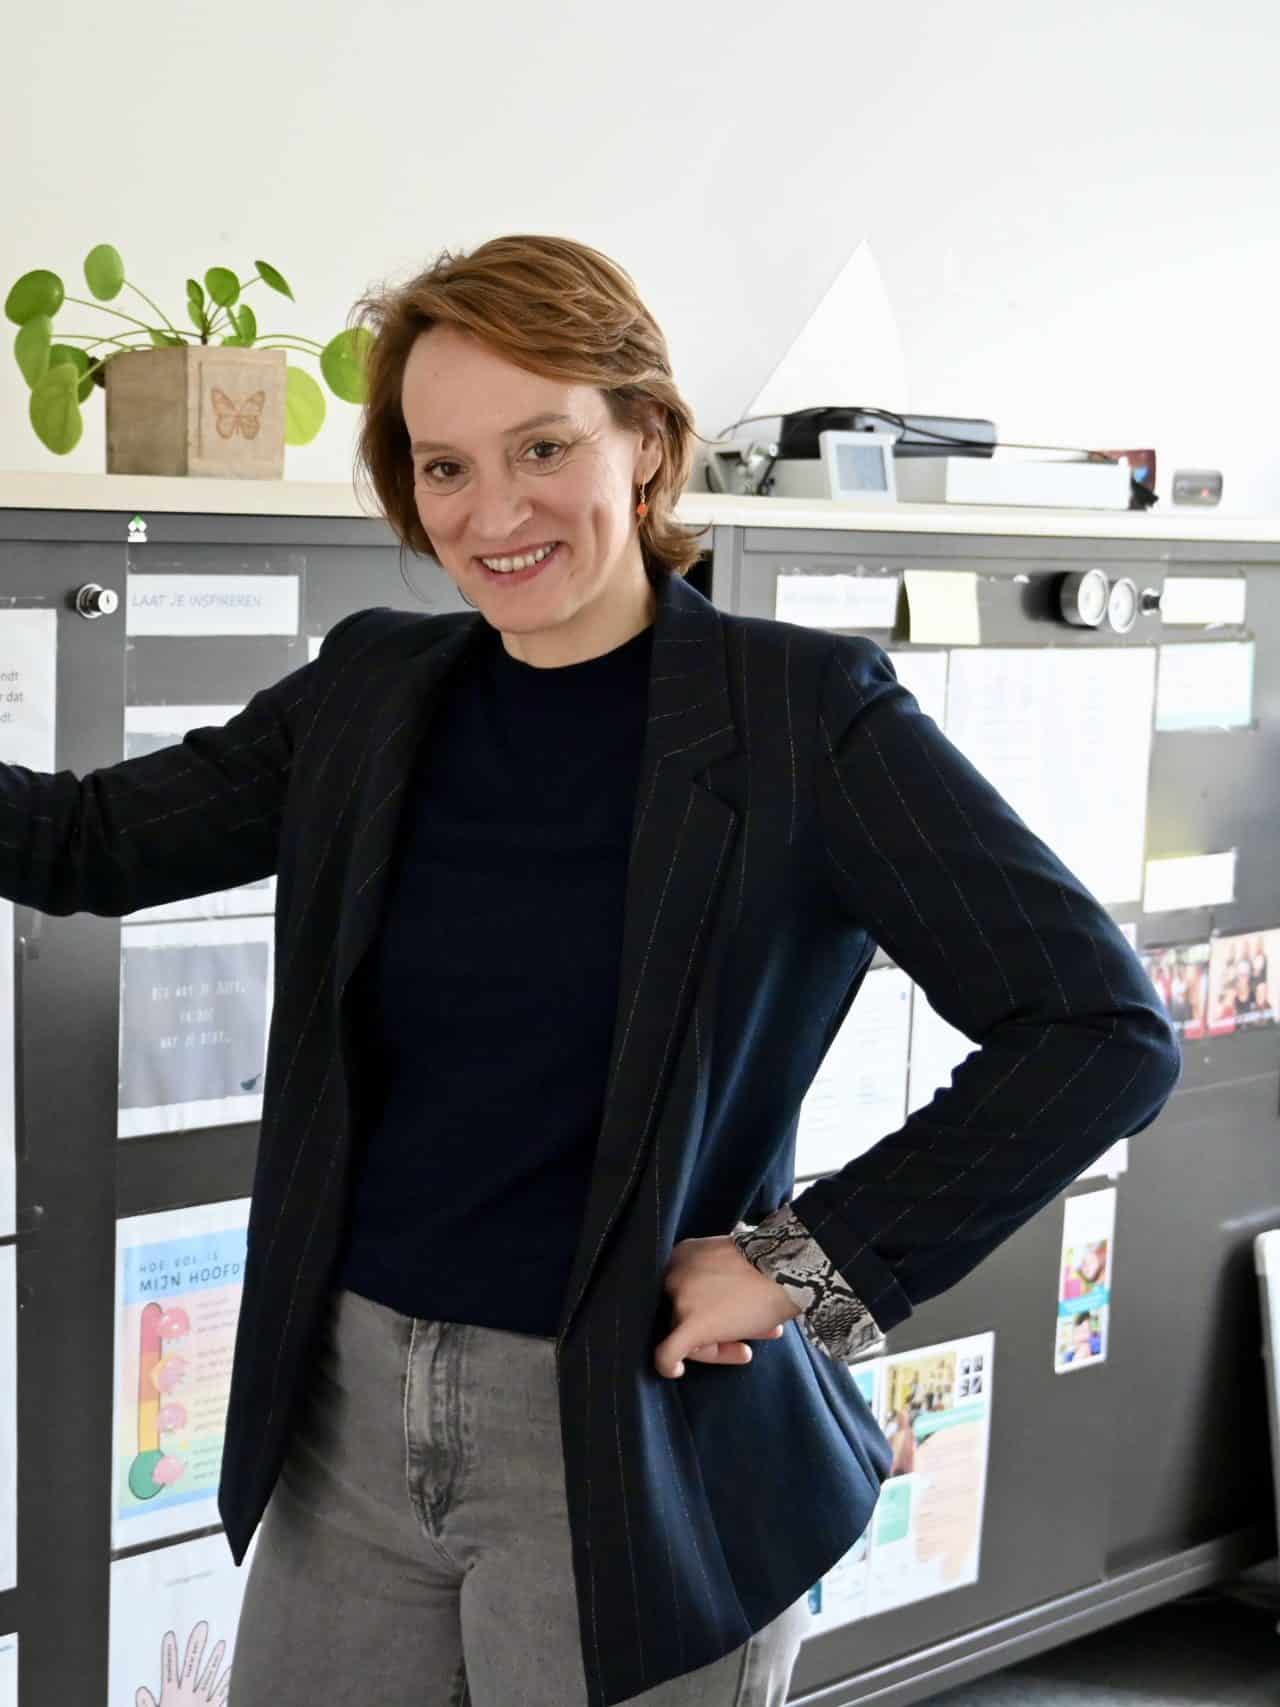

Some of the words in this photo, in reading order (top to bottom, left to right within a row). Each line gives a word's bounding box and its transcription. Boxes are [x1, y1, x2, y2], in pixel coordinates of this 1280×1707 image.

[131, 592, 167, 607] LAAT
[169, 592, 185, 607] JE
[6, 690, 24, 703] dat
[140, 1272, 181, 1292] MIJN
[189, 1263, 241, 1284] HOOFD
